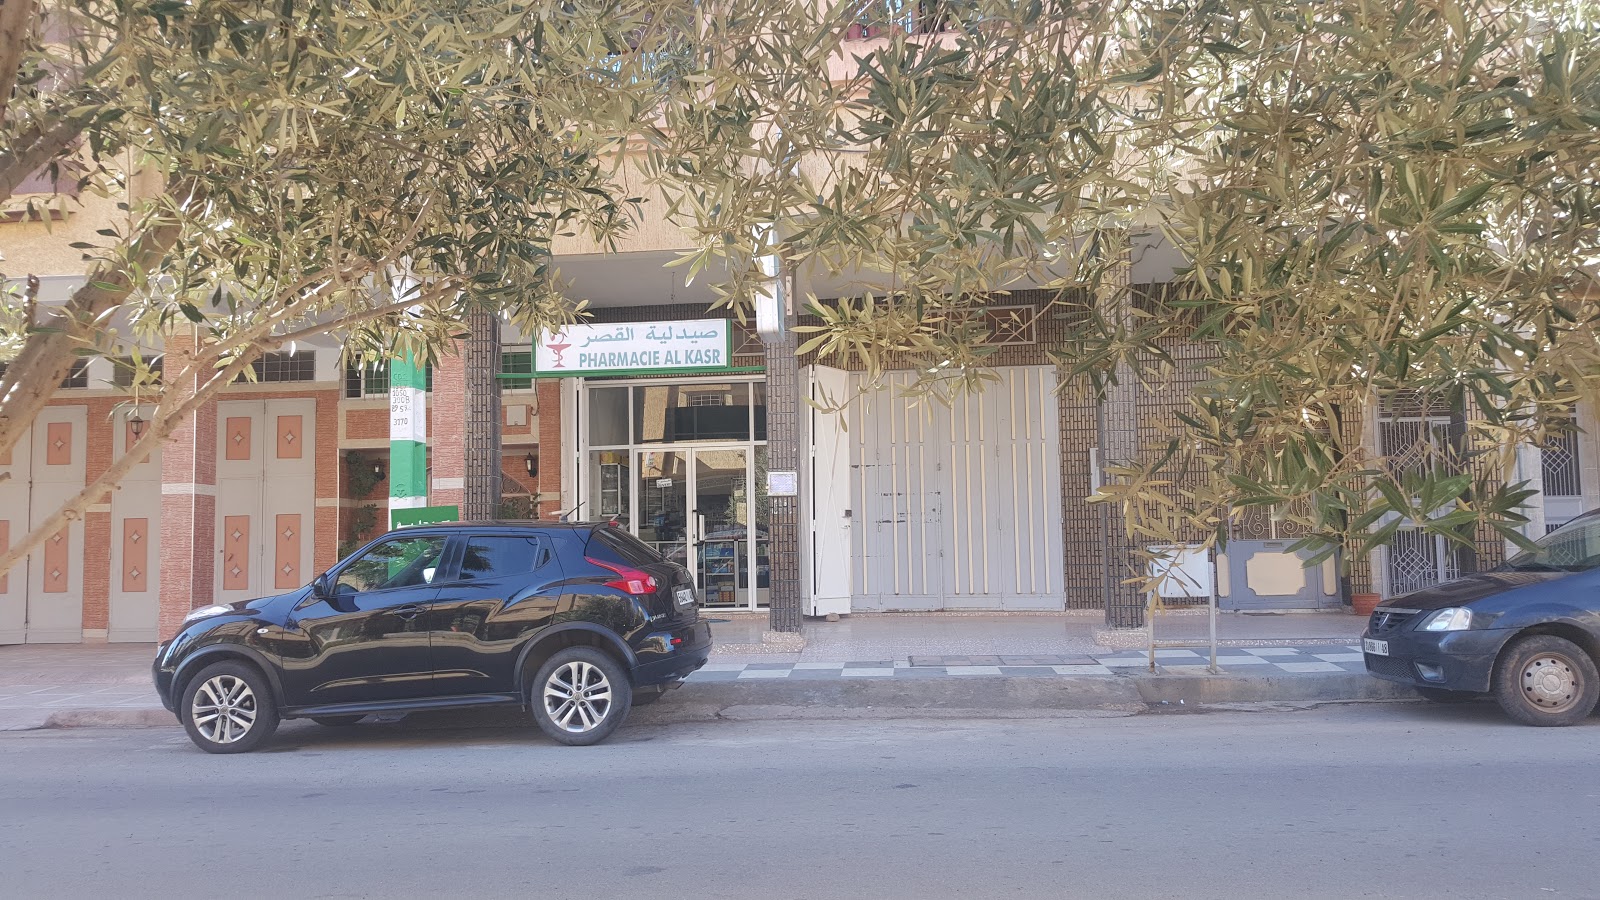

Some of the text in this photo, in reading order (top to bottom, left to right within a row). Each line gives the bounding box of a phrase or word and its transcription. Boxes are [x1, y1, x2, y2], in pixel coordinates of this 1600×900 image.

[579, 325, 719, 348] صيدلية القصر
[579, 348, 721, 368] PHARMACIE AL KASR
